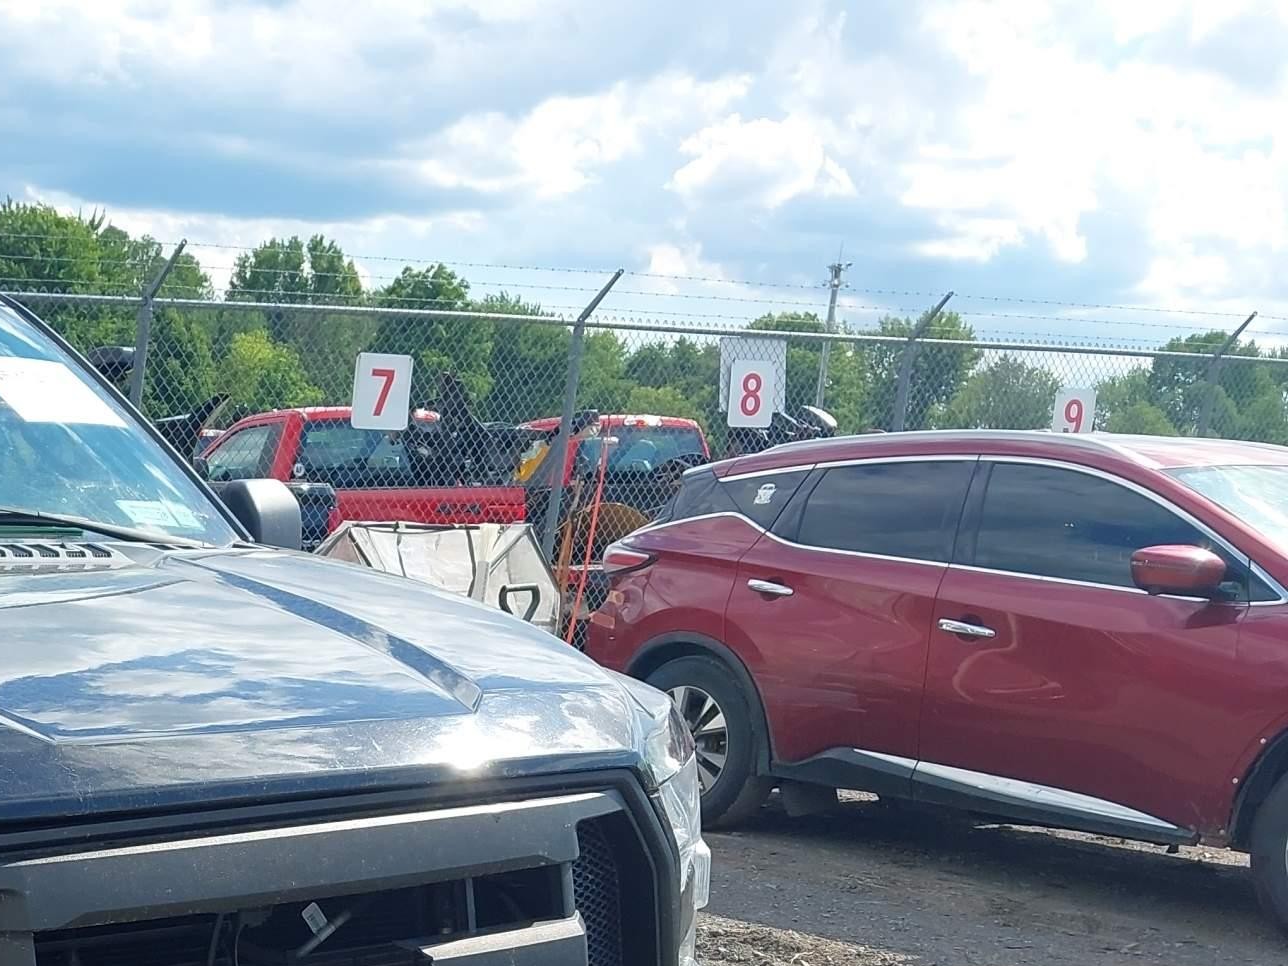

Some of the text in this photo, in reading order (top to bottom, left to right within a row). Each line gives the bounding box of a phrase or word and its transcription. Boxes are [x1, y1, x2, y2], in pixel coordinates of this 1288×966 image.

[371, 368, 395, 417] 7
[740, 372, 762, 417] 8
[1064, 399, 1084, 433] 9
